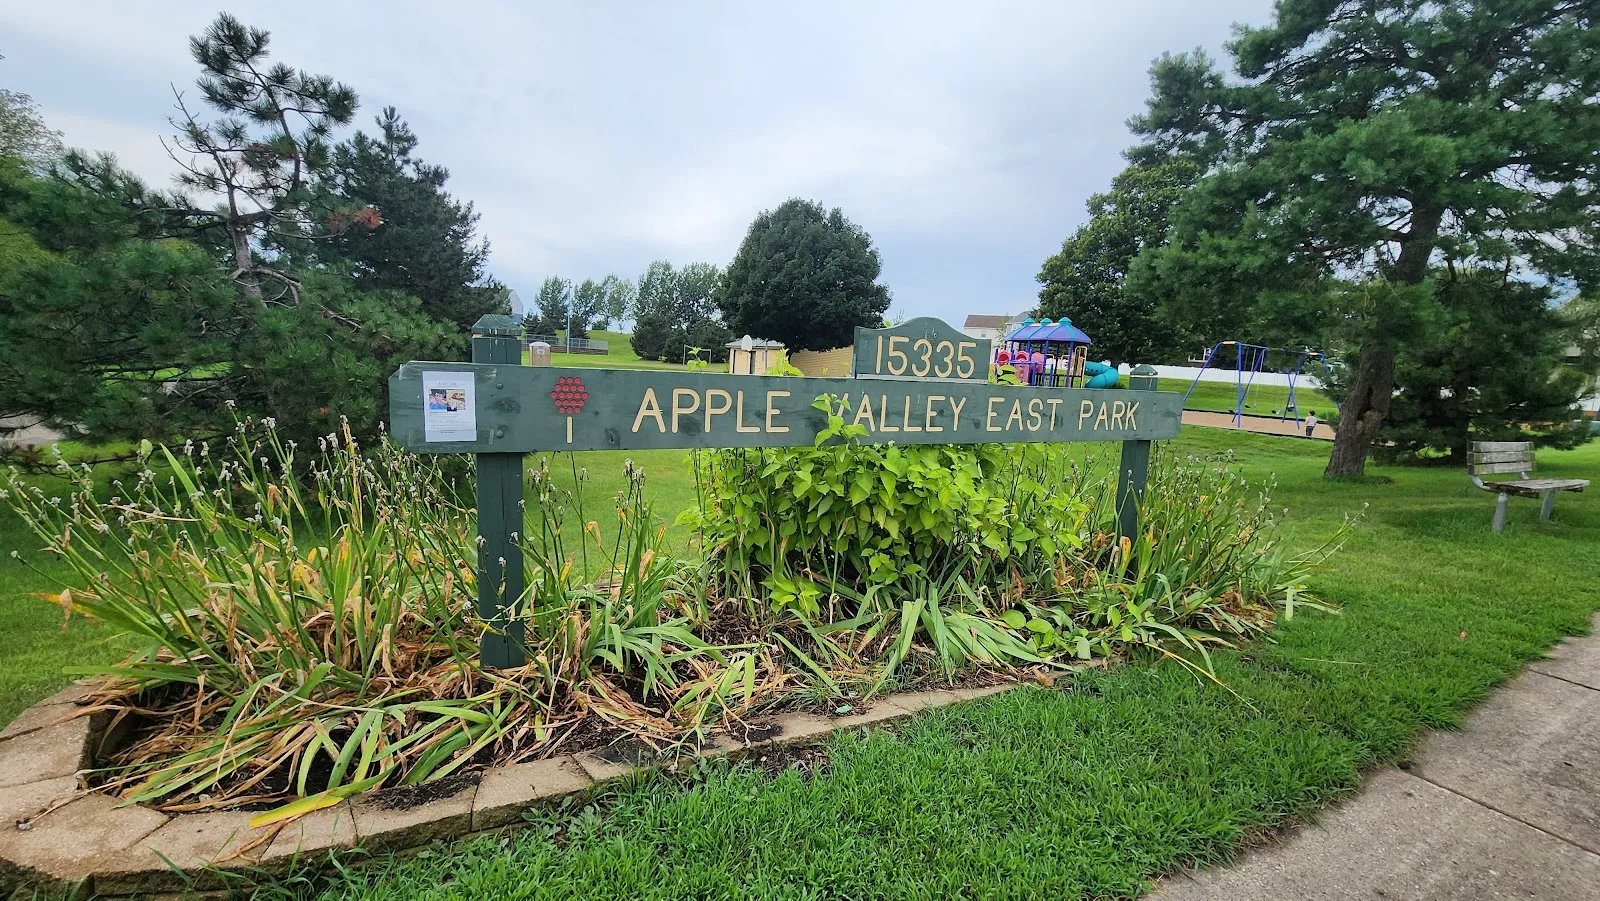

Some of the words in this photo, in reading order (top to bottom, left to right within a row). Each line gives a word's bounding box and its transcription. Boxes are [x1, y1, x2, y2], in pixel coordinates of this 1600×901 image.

[876, 335, 976, 379] 15335
[631, 388, 791, 433] APPLE
[986, 397, 1063, 432] EAST
[1078, 400, 1140, 431] PARK
